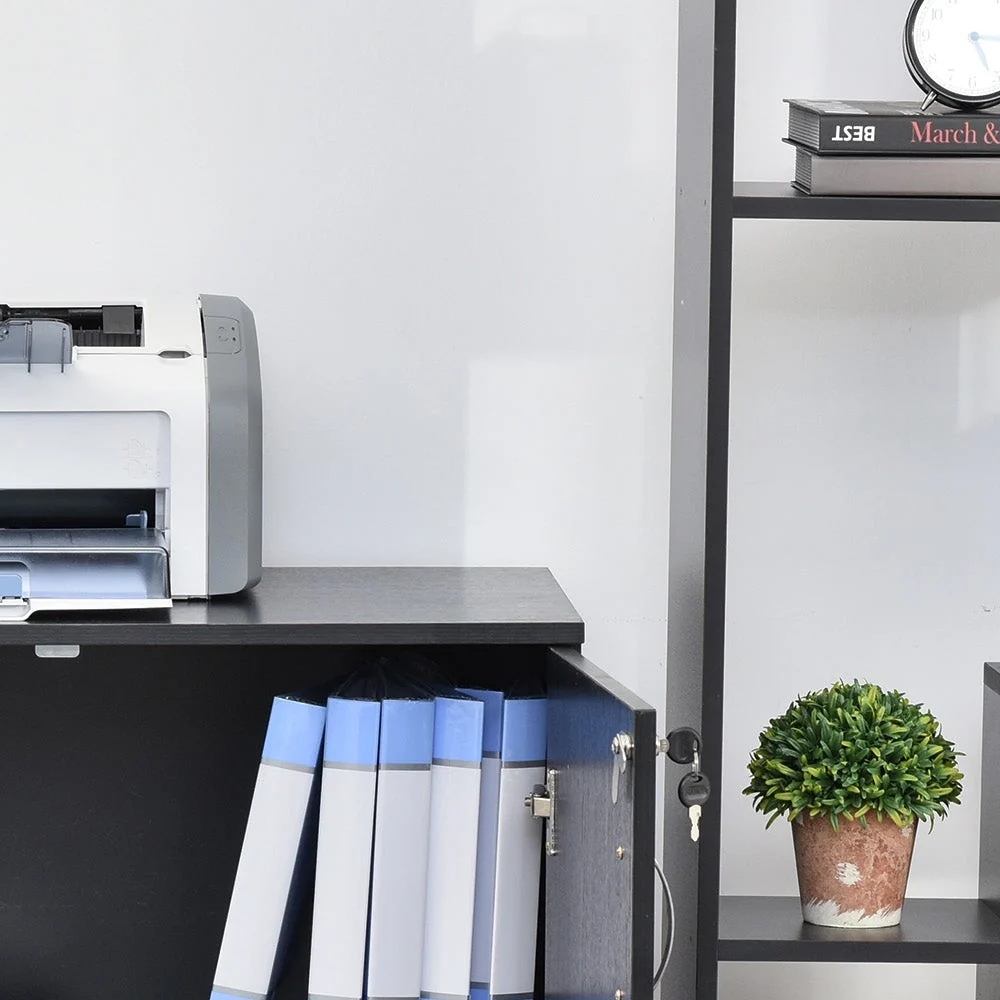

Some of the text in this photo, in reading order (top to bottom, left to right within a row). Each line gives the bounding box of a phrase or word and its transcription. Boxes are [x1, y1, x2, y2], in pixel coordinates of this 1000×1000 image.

[931, 8, 943, 20] 10
[831, 125, 875, 141] BEST
[911, 120, 1000, 144] March &
